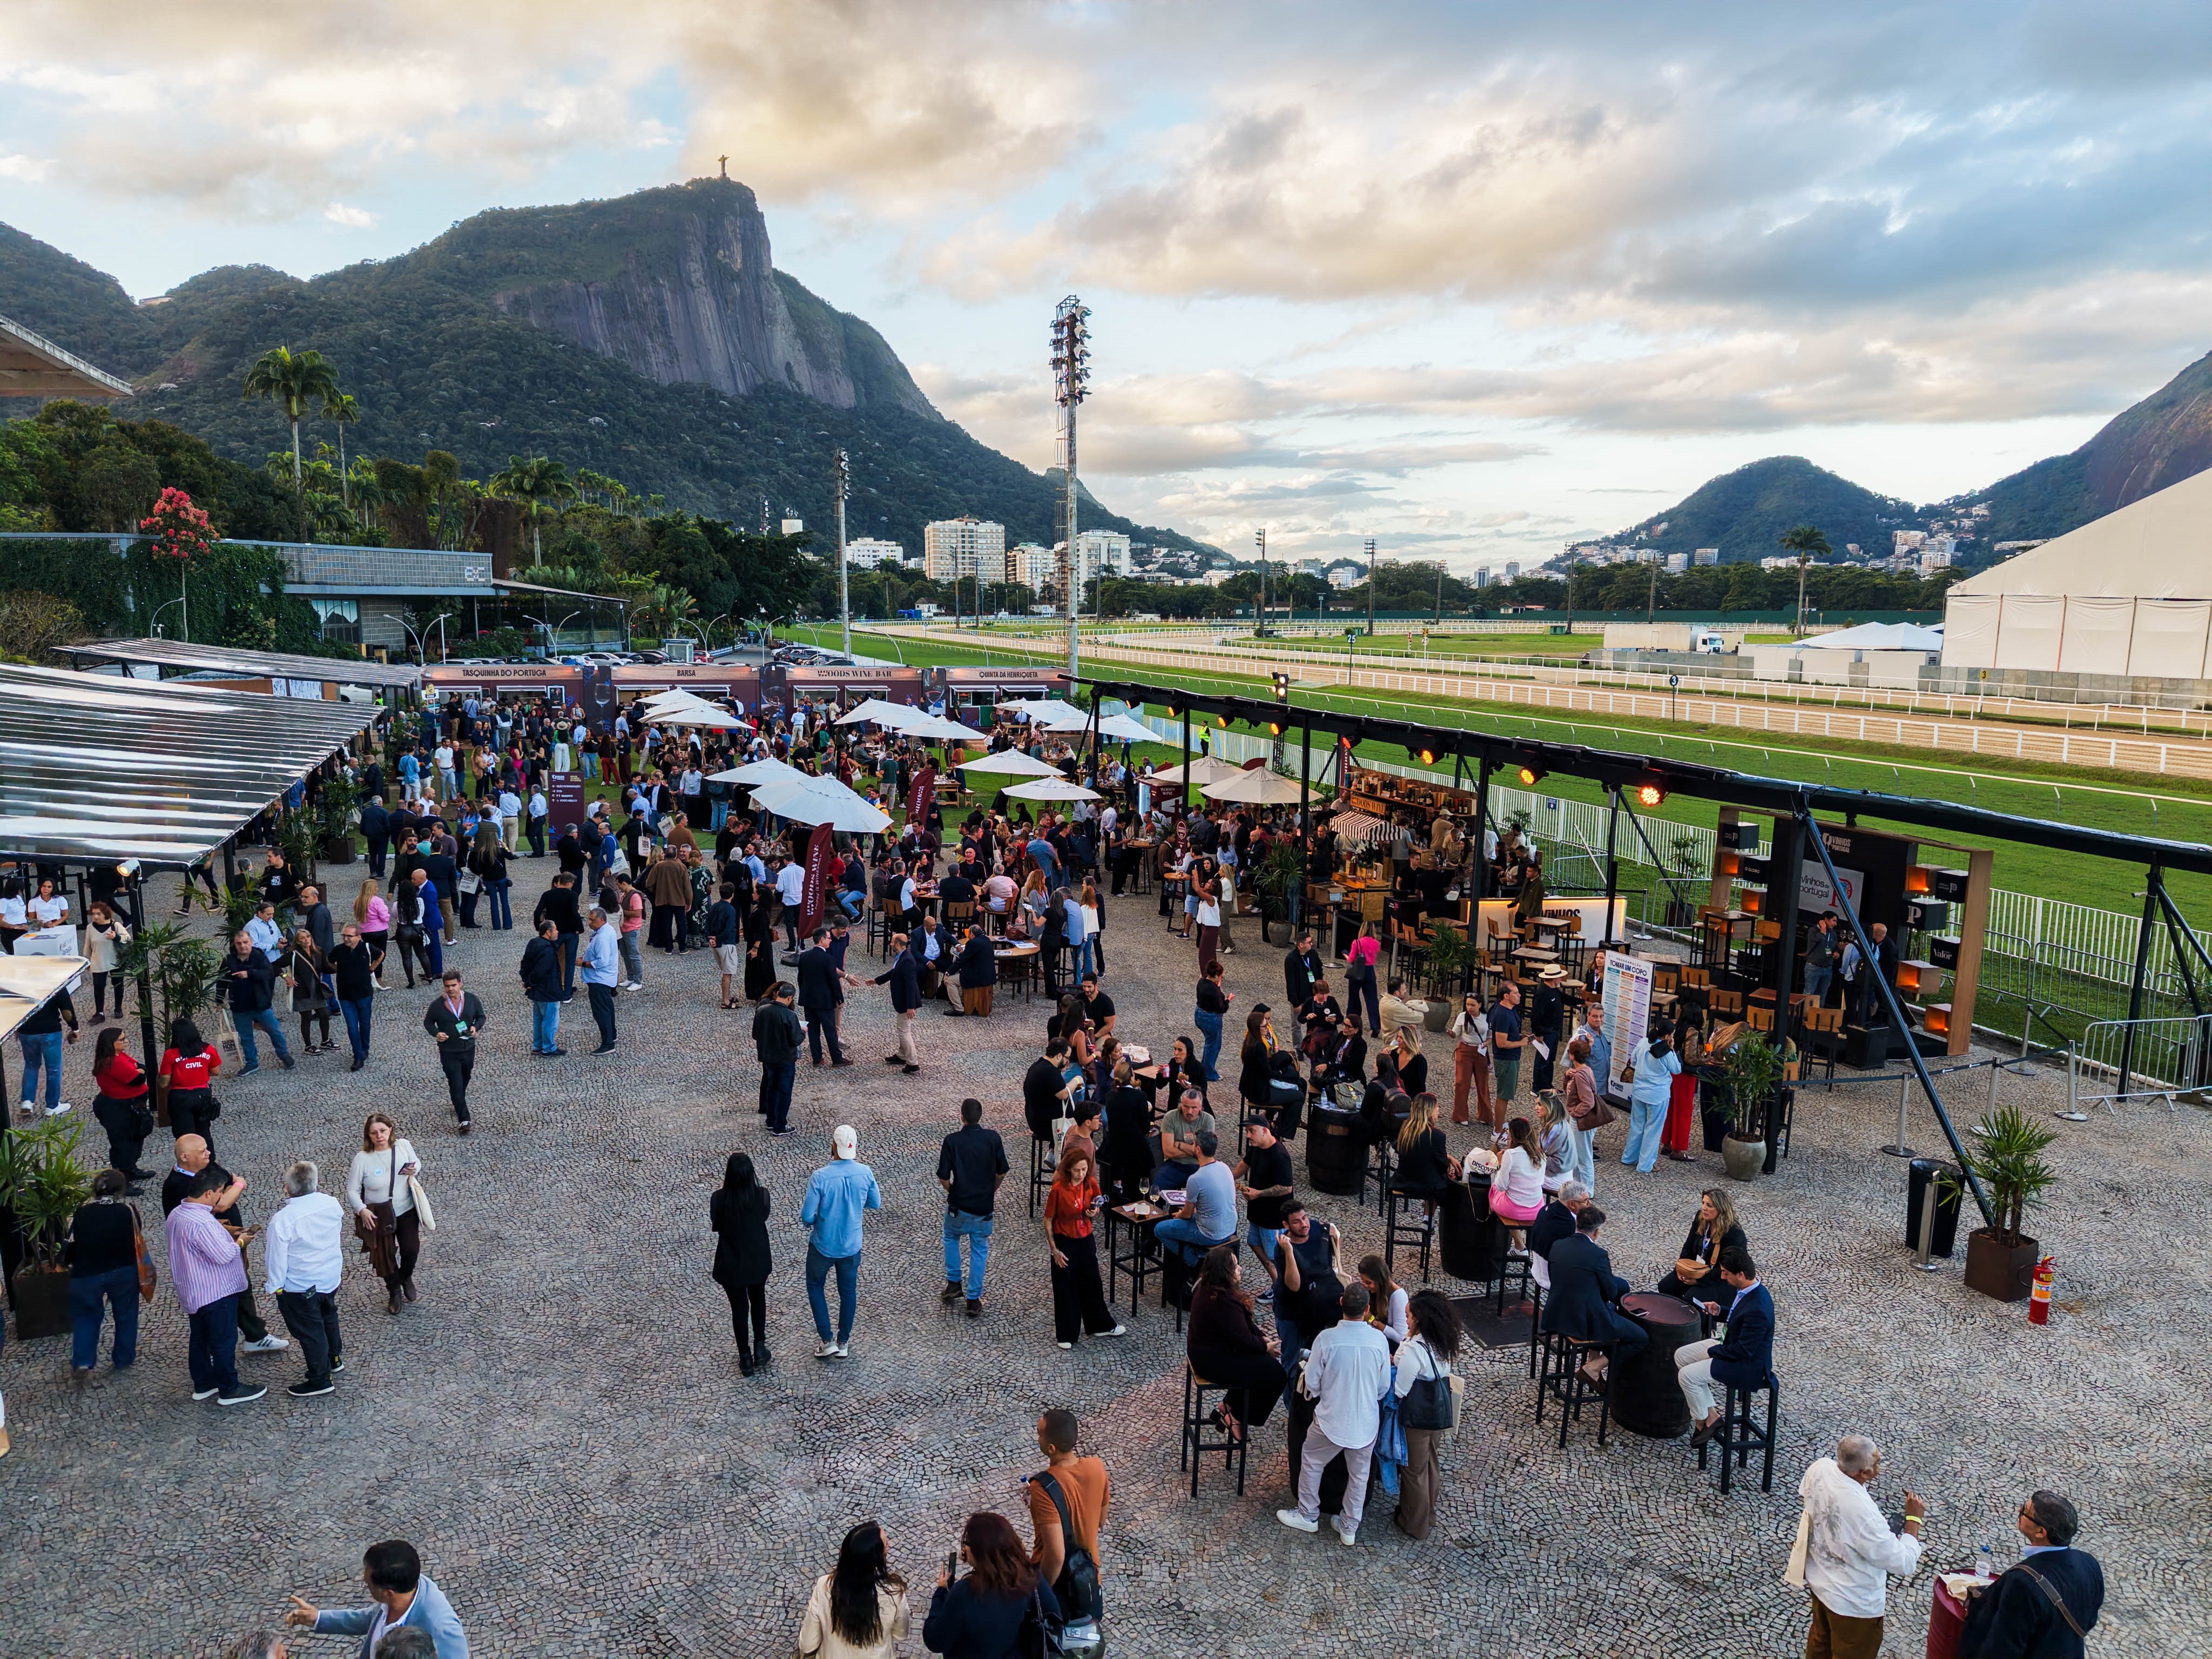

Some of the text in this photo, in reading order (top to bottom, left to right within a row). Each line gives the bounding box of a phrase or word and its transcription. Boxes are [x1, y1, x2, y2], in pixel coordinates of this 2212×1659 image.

[1347, 635, 1356, 643] 25
[1982, 670, 1986, 679] 3
[1672, 676, 1676, 685] 3
[807, 874, 815, 915] WOODS
[1933, 948, 1952, 960] Valor
[1610, 959, 1625, 970] TOMAR
[1631, 967, 1647, 976] COPO
